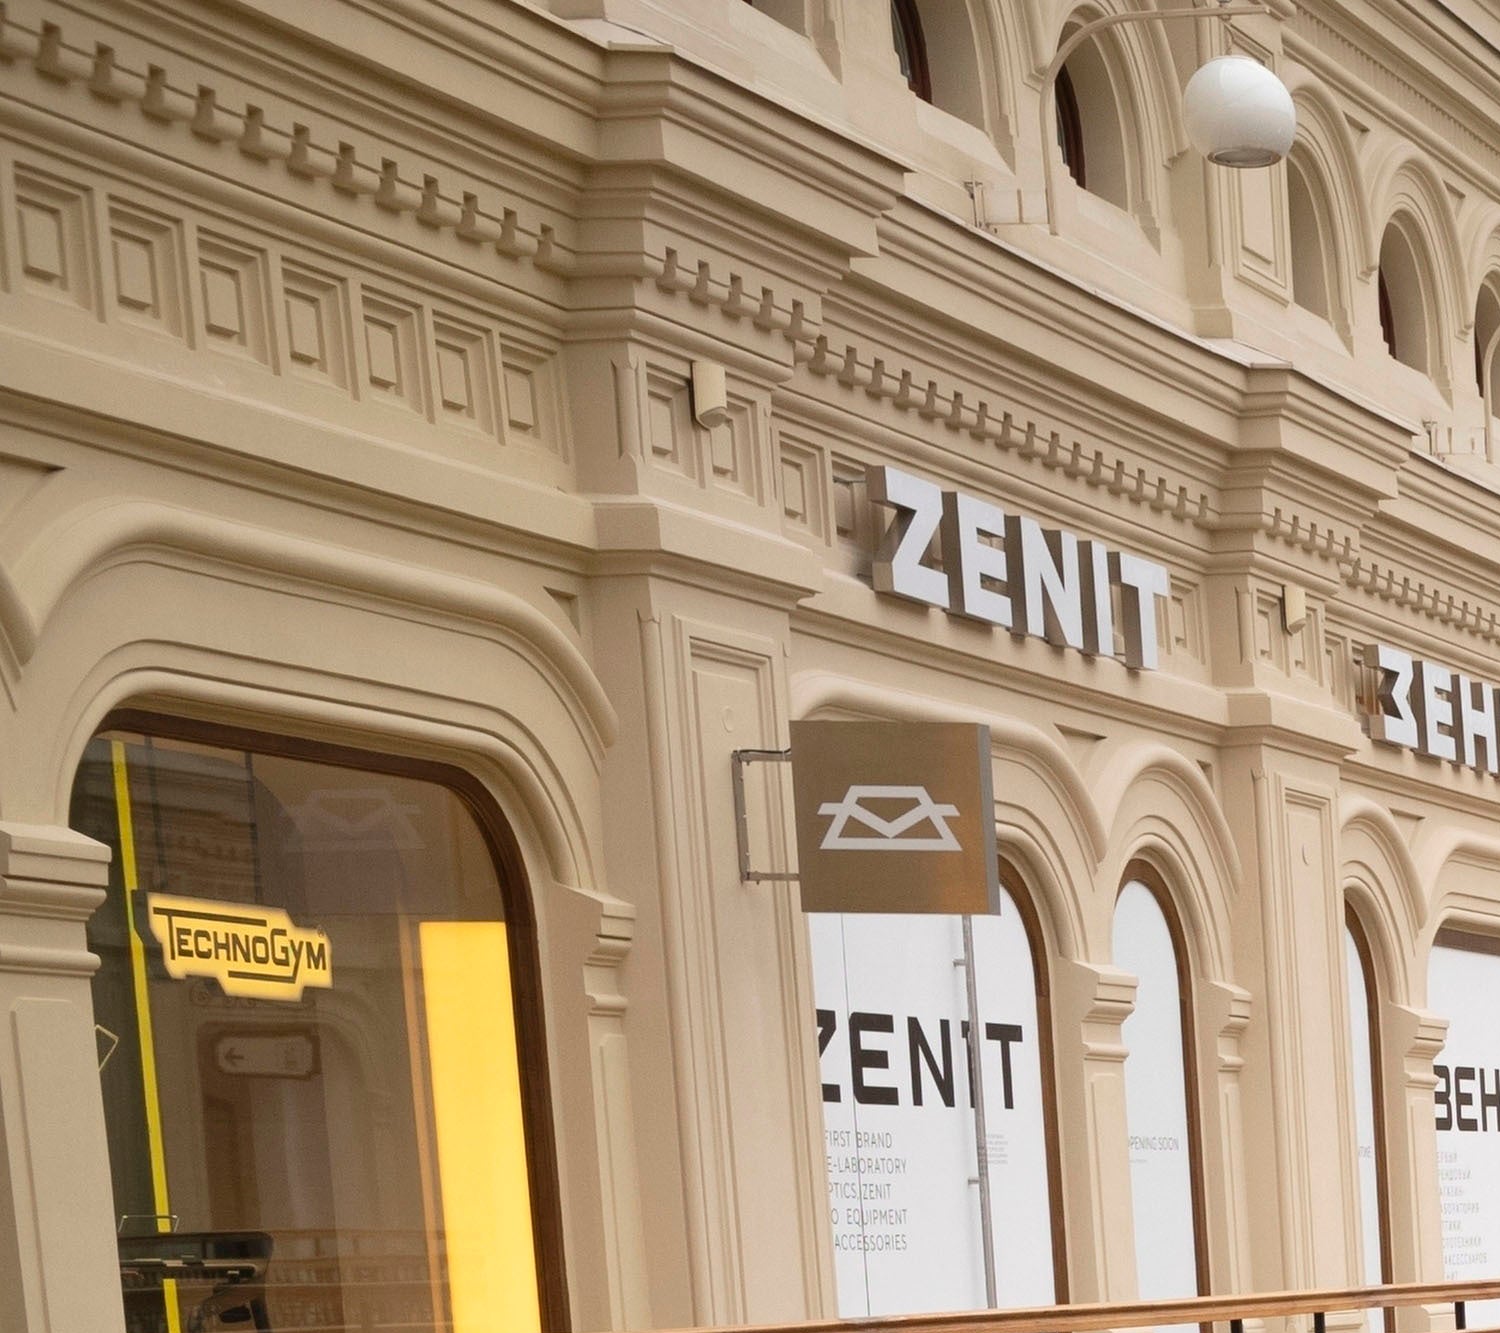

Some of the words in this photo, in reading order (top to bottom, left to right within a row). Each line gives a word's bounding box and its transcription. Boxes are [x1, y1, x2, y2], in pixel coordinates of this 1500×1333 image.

[867, 464, 1169, 670] ZENIT
[856, 1131, 893, 1149] BRAND
[862, 1183, 892, 1200] ZENIT
[846, 1208, 908, 1226] EQUIPMENT
[834, 1233, 908, 1251] ACCESSORIES
